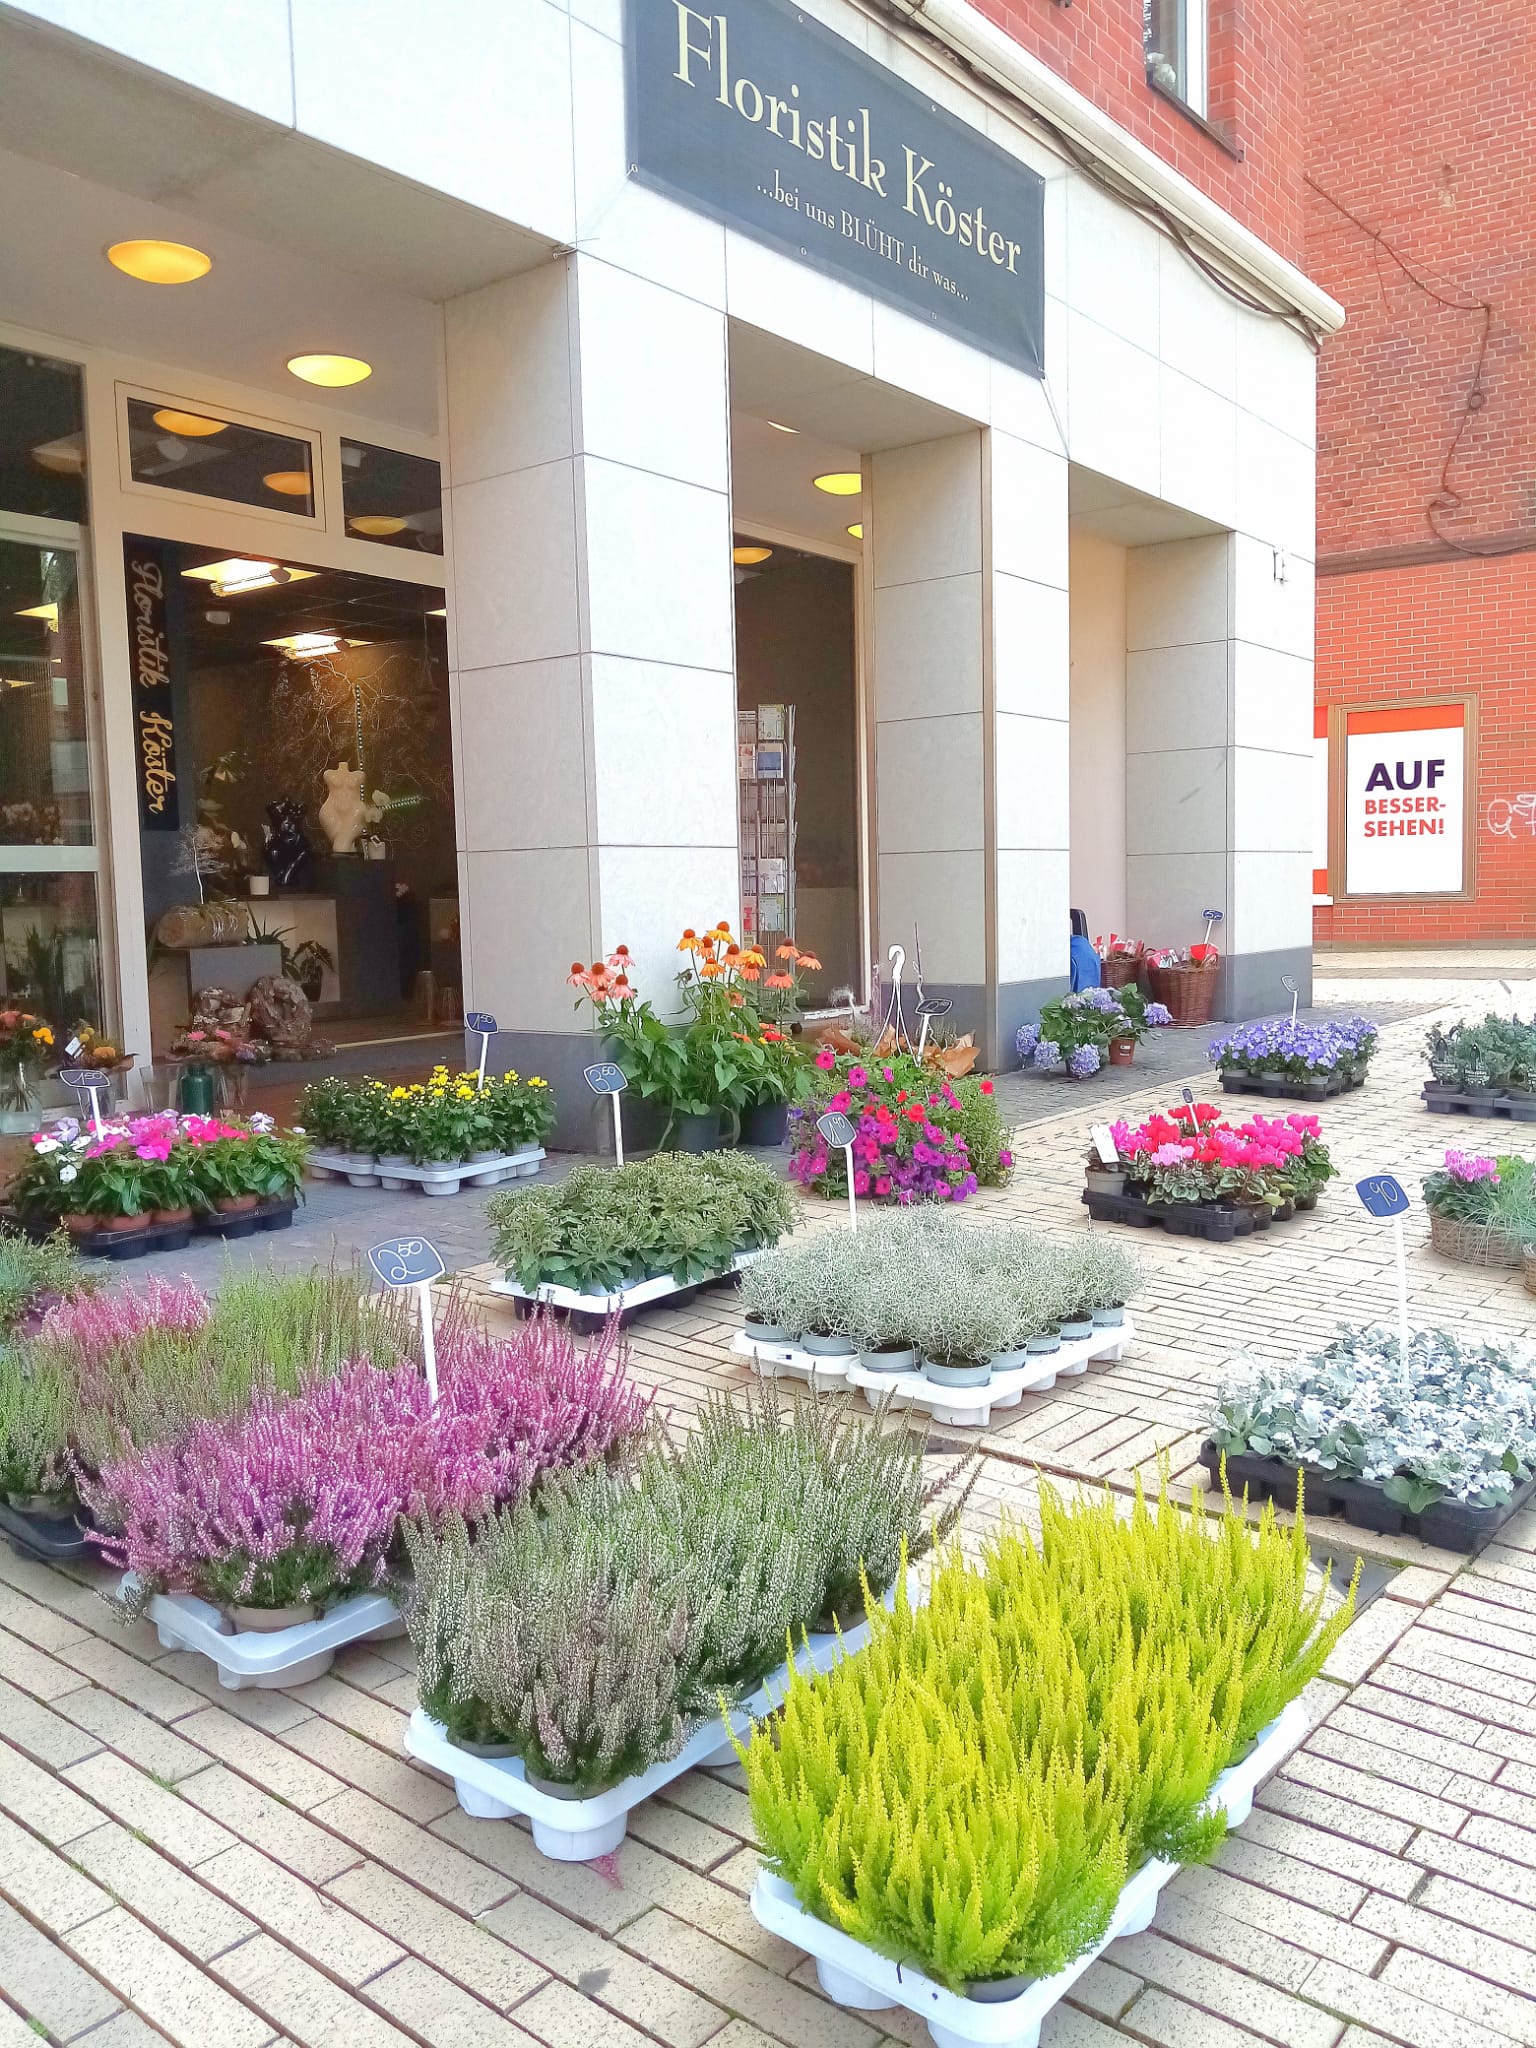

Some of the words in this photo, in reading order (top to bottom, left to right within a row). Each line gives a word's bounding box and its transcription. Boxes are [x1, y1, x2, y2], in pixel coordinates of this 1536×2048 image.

[672, 0, 887, 197] Floristik
[901, 144, 1021, 275] Köster
[756, 170, 800, 211] ...bei
[805, 199, 835, 230] uns
[840, 210, 904, 266] BLÜHT
[908, 246, 929, 279] dir
[932, 269, 969, 302] was...
[131, 560, 170, 689] Floristik
[140, 710, 176, 814] Köster
[1365, 759, 1445, 792] AUF
[1365, 797, 1446, 815] BESSER-
[1364, 818, 1444, 837] SEHEN!
